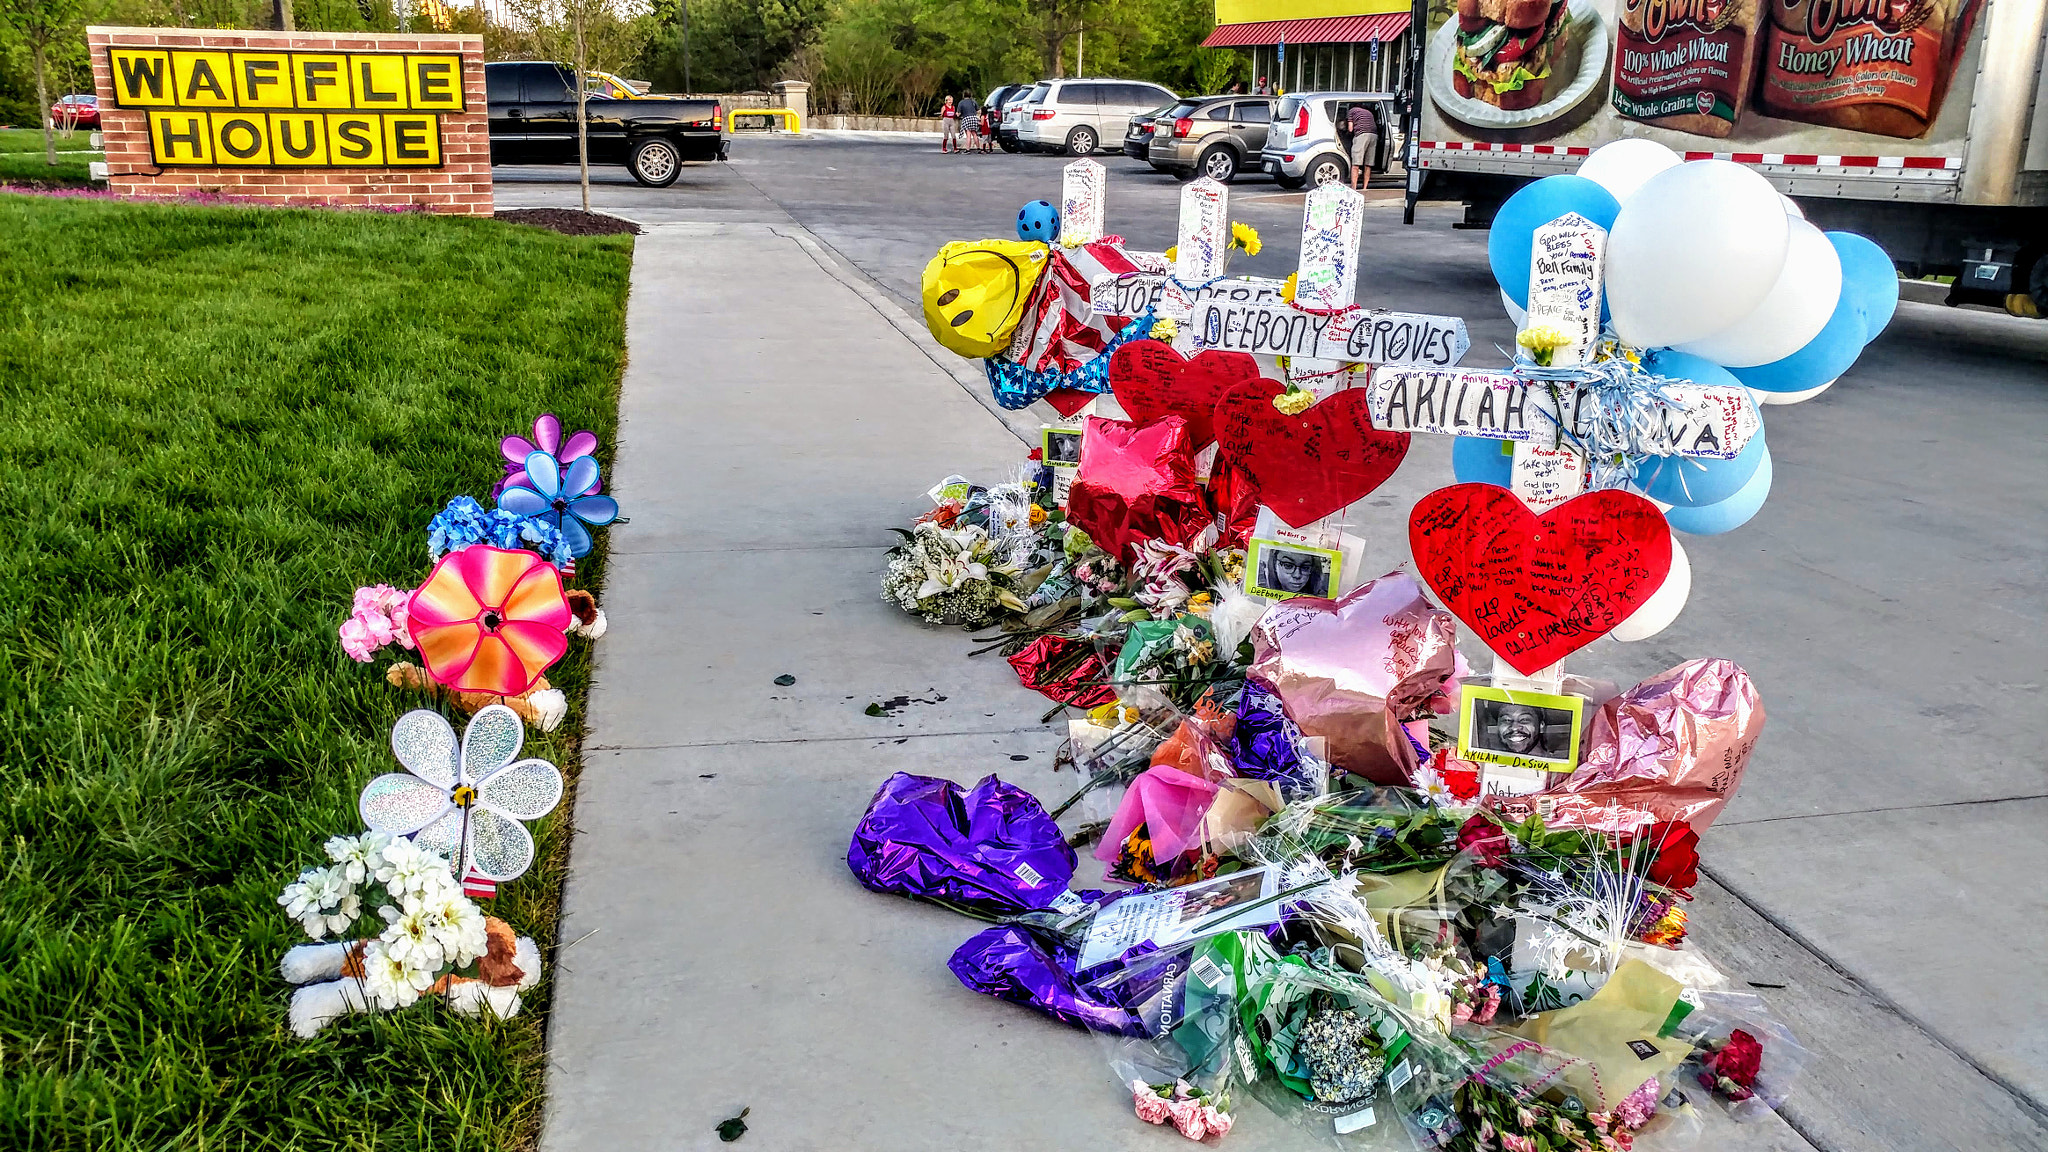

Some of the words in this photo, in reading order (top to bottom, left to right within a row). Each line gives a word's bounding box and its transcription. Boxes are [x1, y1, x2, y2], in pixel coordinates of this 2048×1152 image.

[1623, 48, 1649, 74] 100%
[1651, 43, 1687, 72] Whole
[1689, 37, 1729, 63] Wheat
[1778, 42, 1842, 76] Honey
[1845, 33, 1915, 65] Wheat
[117, 57, 454, 102] WAFFLE
[1683, 66, 1700, 76] Colors
[1708, 66, 1728, 79] Flavors
[1855, 71, 1878, 83] Colors
[1880, 71, 1889, 80] or
[1890, 70, 1917, 86] Flavors
[1865, 84, 1885, 96] Syrup
[1614, 90, 1623, 107] 14
[1632, 102, 1659, 117] Whole
[1661, 97, 1686, 114] Grain
[160, 118, 429, 160] HOUSE
[1546, 240, 1572, 253] BLESS
[1537, 258, 1559, 275] Bell
[1561, 260, 1594, 280] Family
[1203, 304, 1330, 358] DE'EBONY
[1347, 317, 1455, 366] GROVES
[1394, 372, 1422, 380] Taylor
[1426, 372, 1457, 381] Family
[1387, 375, 1528, 433] AKILAH
[1519, 459, 1541, 470] Take
[1523, 480, 1539, 488] God
[1538, 495, 1568, 506] forgotten
[1531, 560, 1554, 570] always
[1557, 560, 1567, 570] be
[1250, 587, 1284, 601] DeEbony
[1532, 583, 1546, 593] love
[1463, 748, 1499, 763] AKILAH
